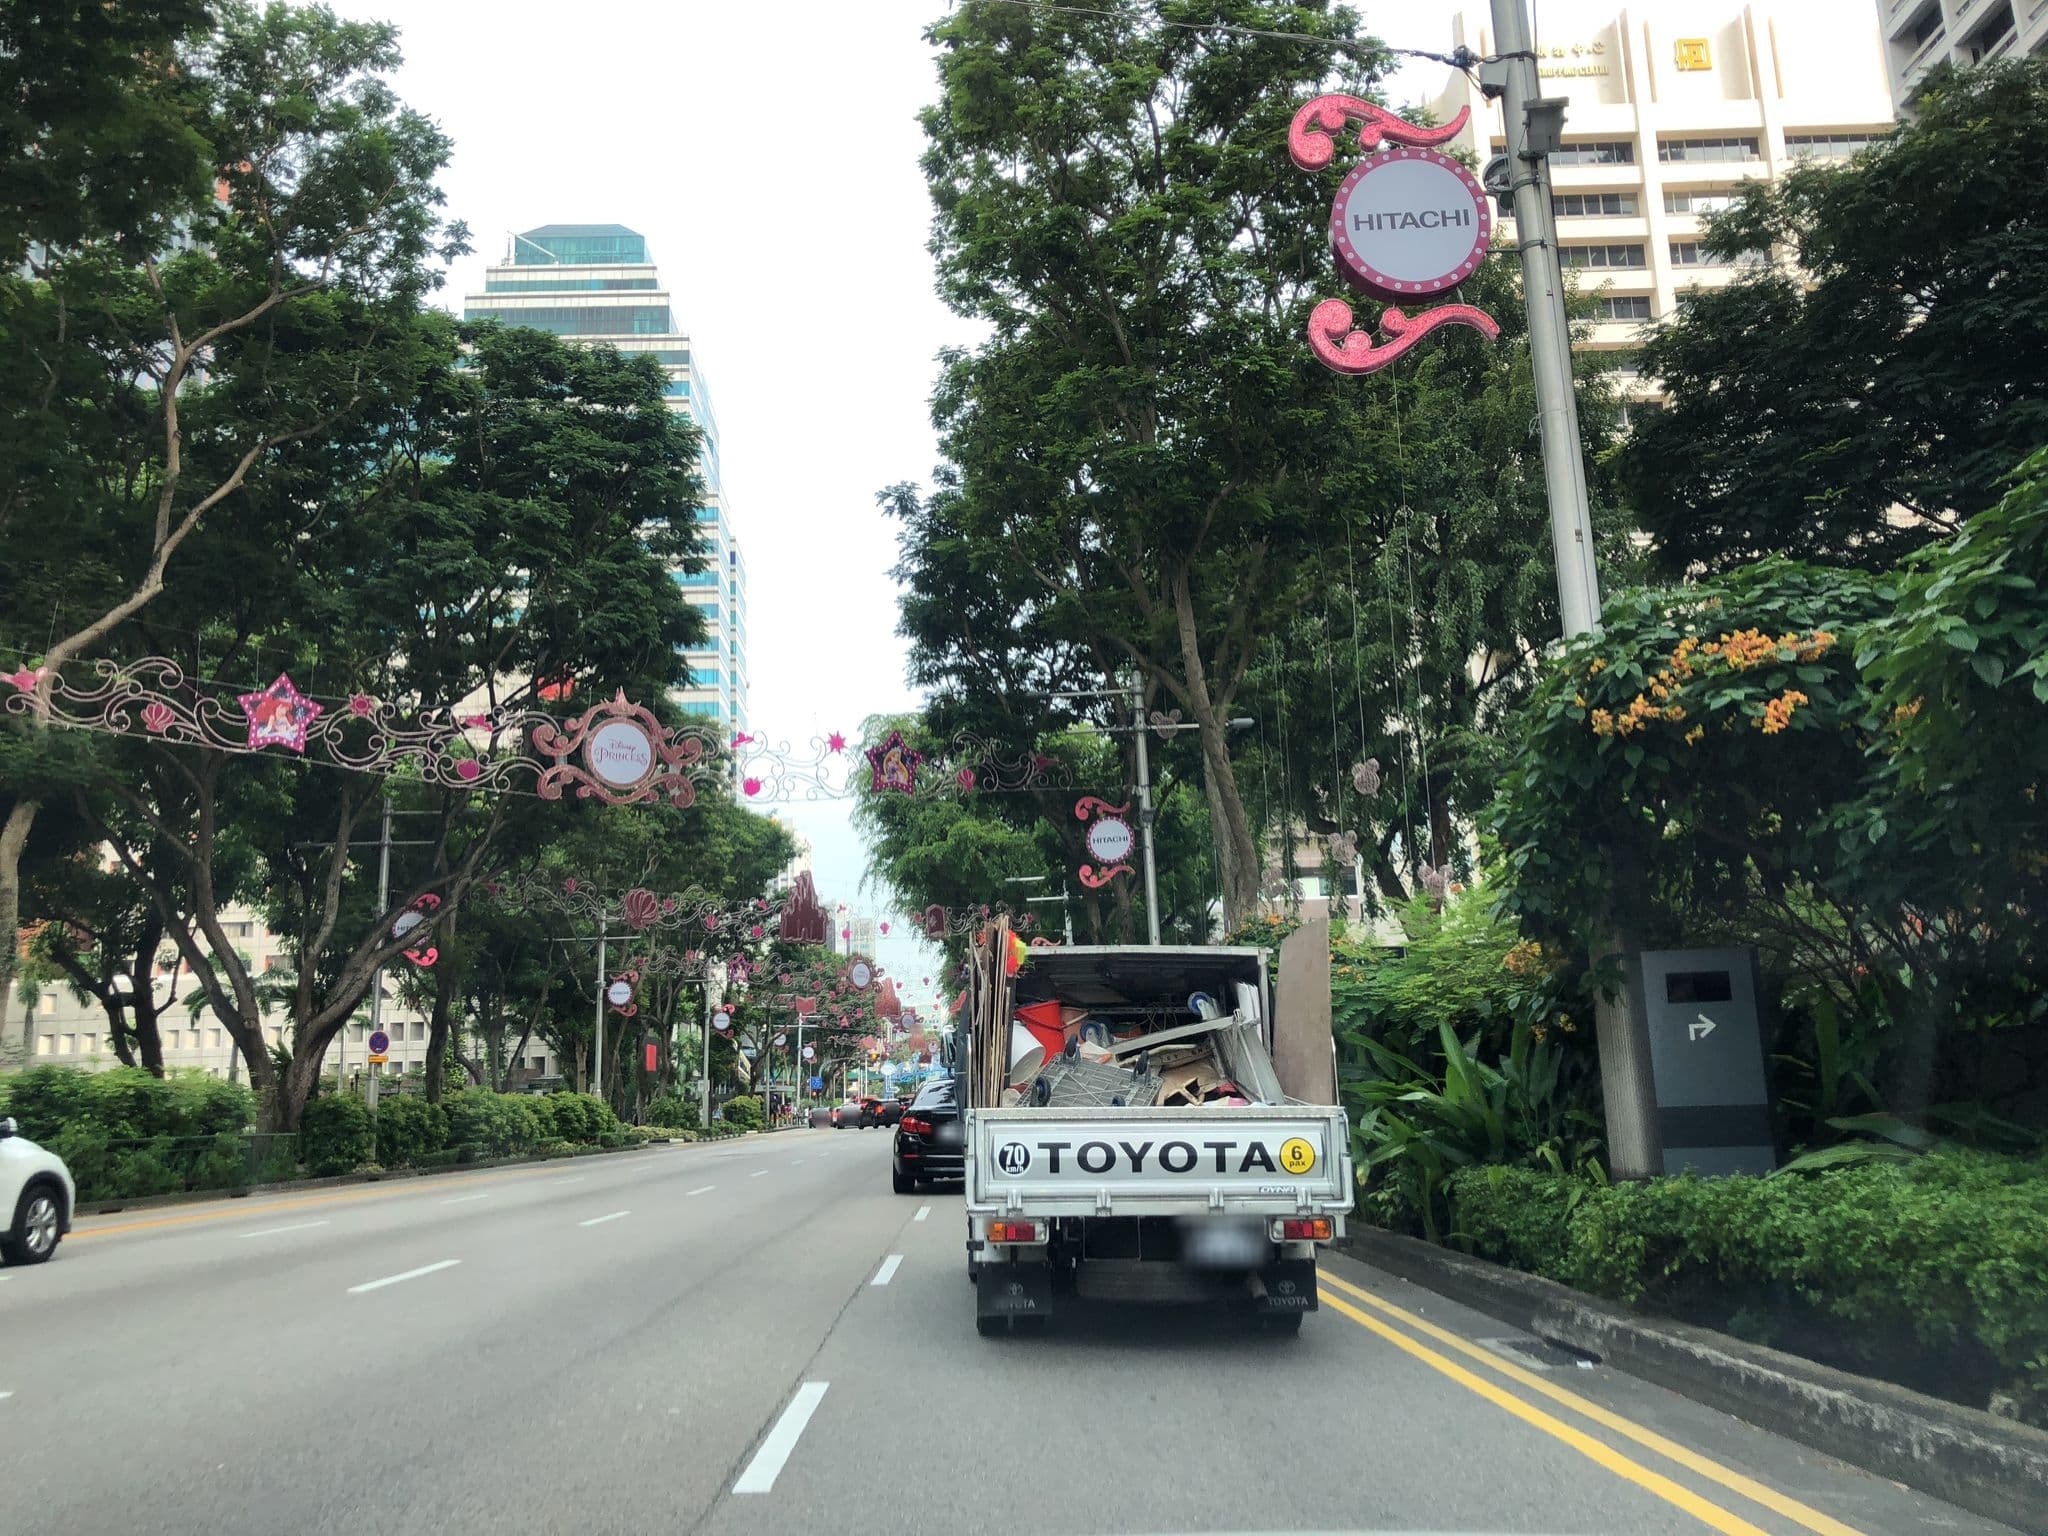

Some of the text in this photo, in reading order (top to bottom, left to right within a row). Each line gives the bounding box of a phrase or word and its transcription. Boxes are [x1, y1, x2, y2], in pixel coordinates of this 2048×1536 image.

[1353, 208, 1471, 231] HITACHI
[1092, 835, 1129, 845] HITACHI
[1003, 1145, 1025, 1167] 70
[1037, 1141, 1277, 1174] TOYOTA
[1291, 1145, 1303, 1160] 6
[1289, 1160, 1306, 1169] pax
